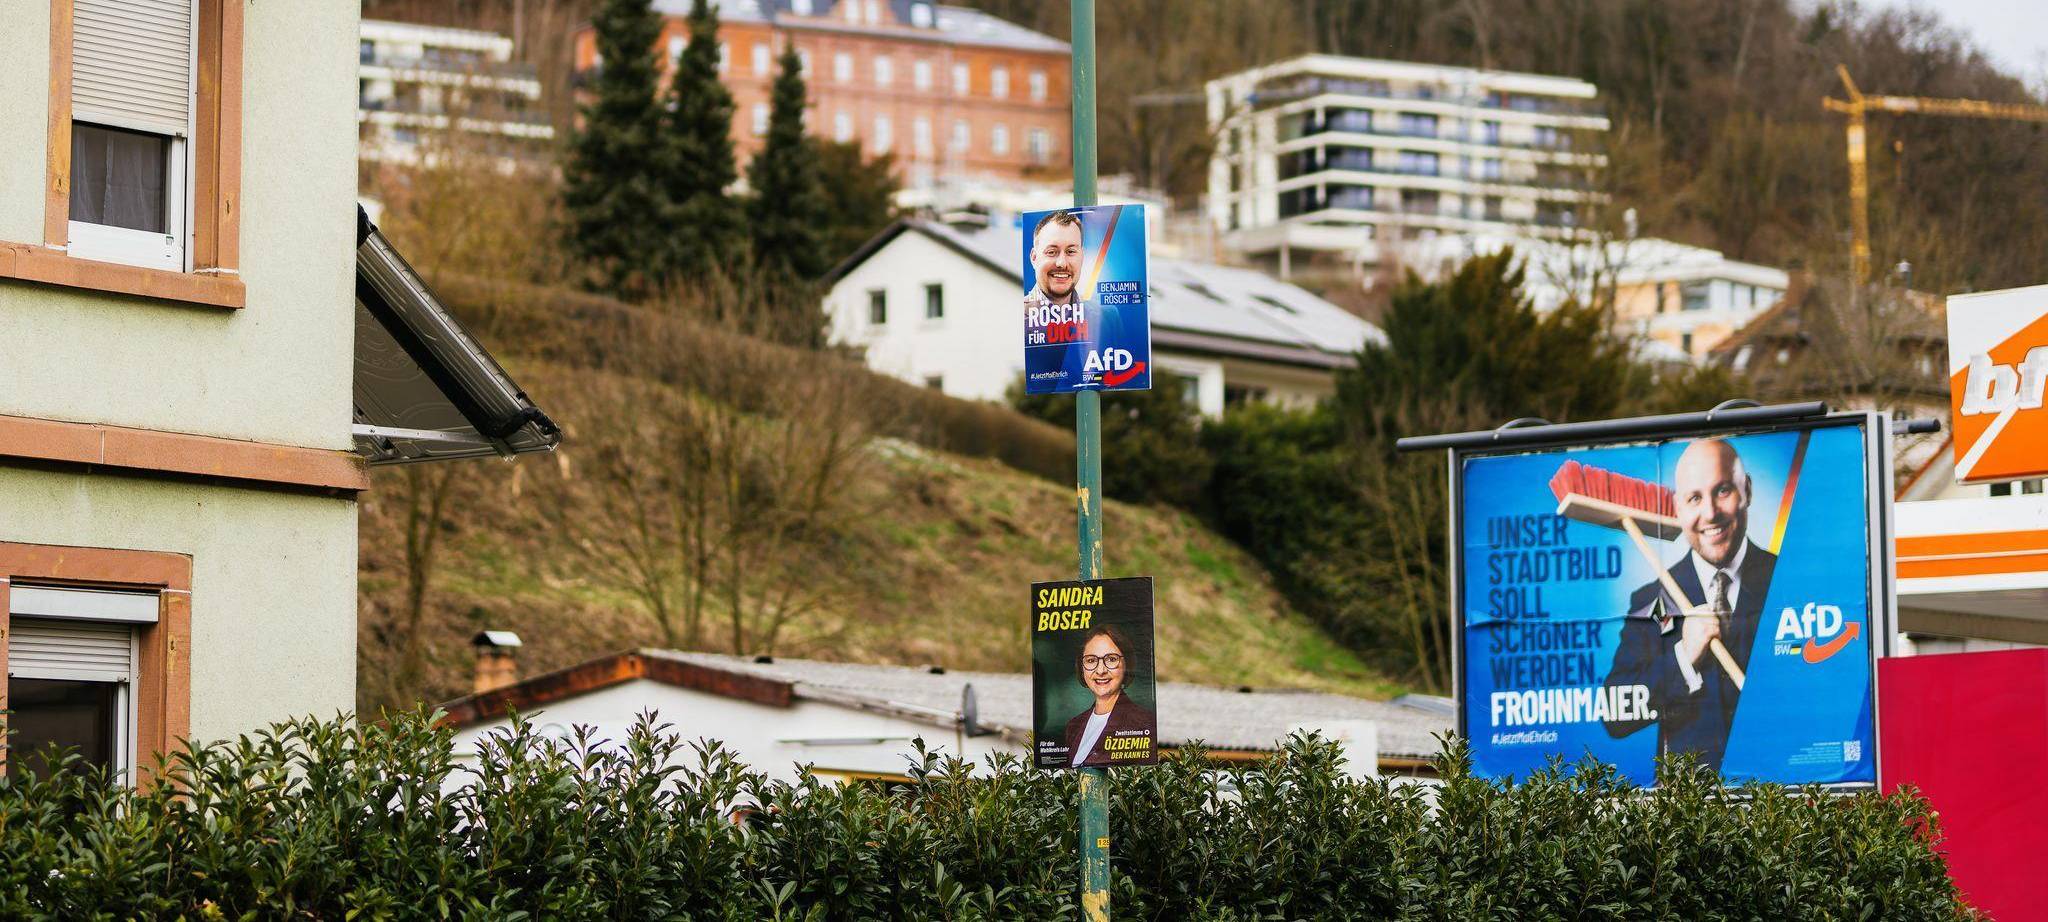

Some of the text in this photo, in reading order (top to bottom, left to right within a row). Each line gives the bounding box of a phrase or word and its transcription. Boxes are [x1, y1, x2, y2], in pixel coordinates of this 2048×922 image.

[1100, 282, 1137, 292] BENJAMIN
[1104, 292, 1128, 304] RÖSCH
[1028, 300, 1085, 327] RÖSCH
[1028, 319, 1089, 344] FÜR DICH
[1083, 346, 1133, 372] AfD
[1030, 370, 1068, 380] #JetztMalEhrlich
[1083, 374, 1094, 382] BW
[1488, 512, 1568, 549] UNSER
[1488, 544, 1622, 585] STADTBILD
[1037, 585, 1103, 609] SANDRA
[1488, 586, 1550, 620] SOLL
[1037, 610, 1092, 632] BOSER
[1775, 602, 1843, 640] AfD
[1774, 643, 1791, 656] BW
[1489, 651, 1604, 689] WERDEN.
[1491, 684, 1658, 727] FROHNMAIER.
[1104, 736, 1151, 751] ÖZDEMIR
[1491, 730, 1558, 746] #JetztMalEhrlich
[1111, 750, 1151, 760] DER KANN ES
